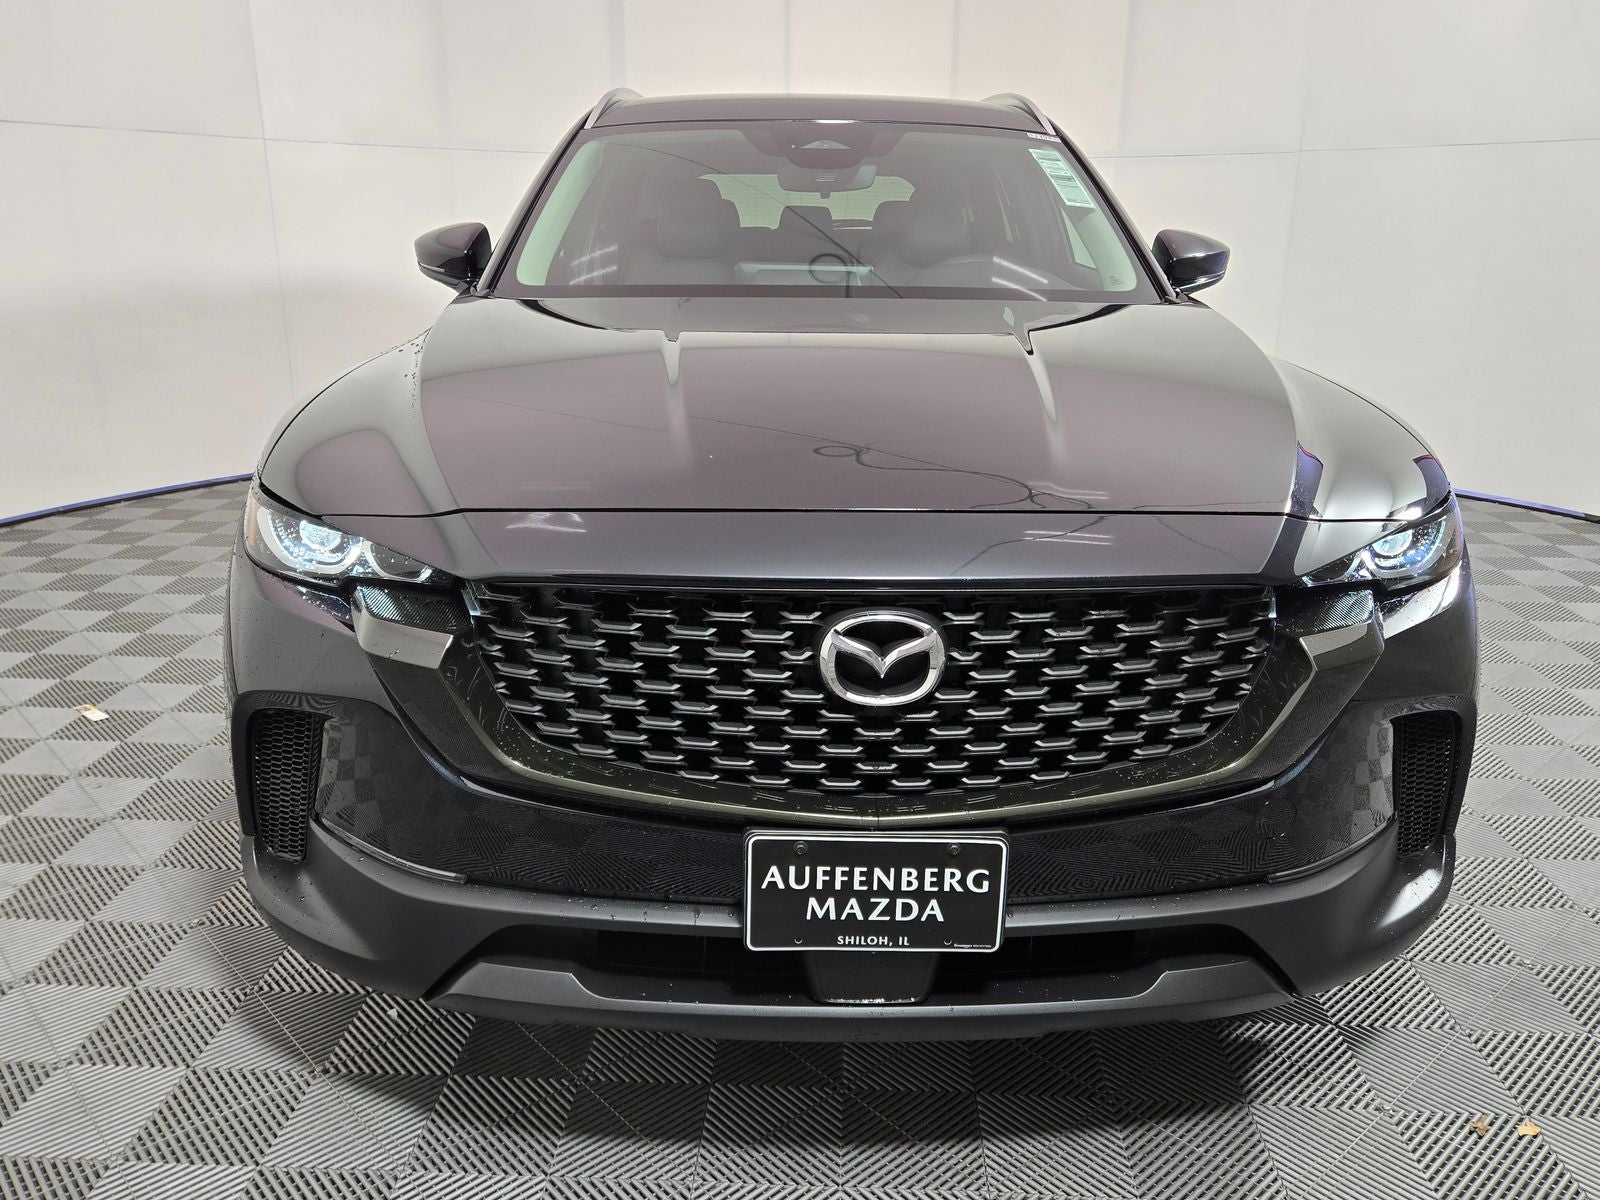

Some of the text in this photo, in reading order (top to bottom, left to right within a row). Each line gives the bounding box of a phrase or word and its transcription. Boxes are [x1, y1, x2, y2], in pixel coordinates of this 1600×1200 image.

[761, 865, 990, 893] AUFFENBERG
[806, 897, 945, 922] MAZDA
[837, 935, 910, 947] SHILOH, IL
